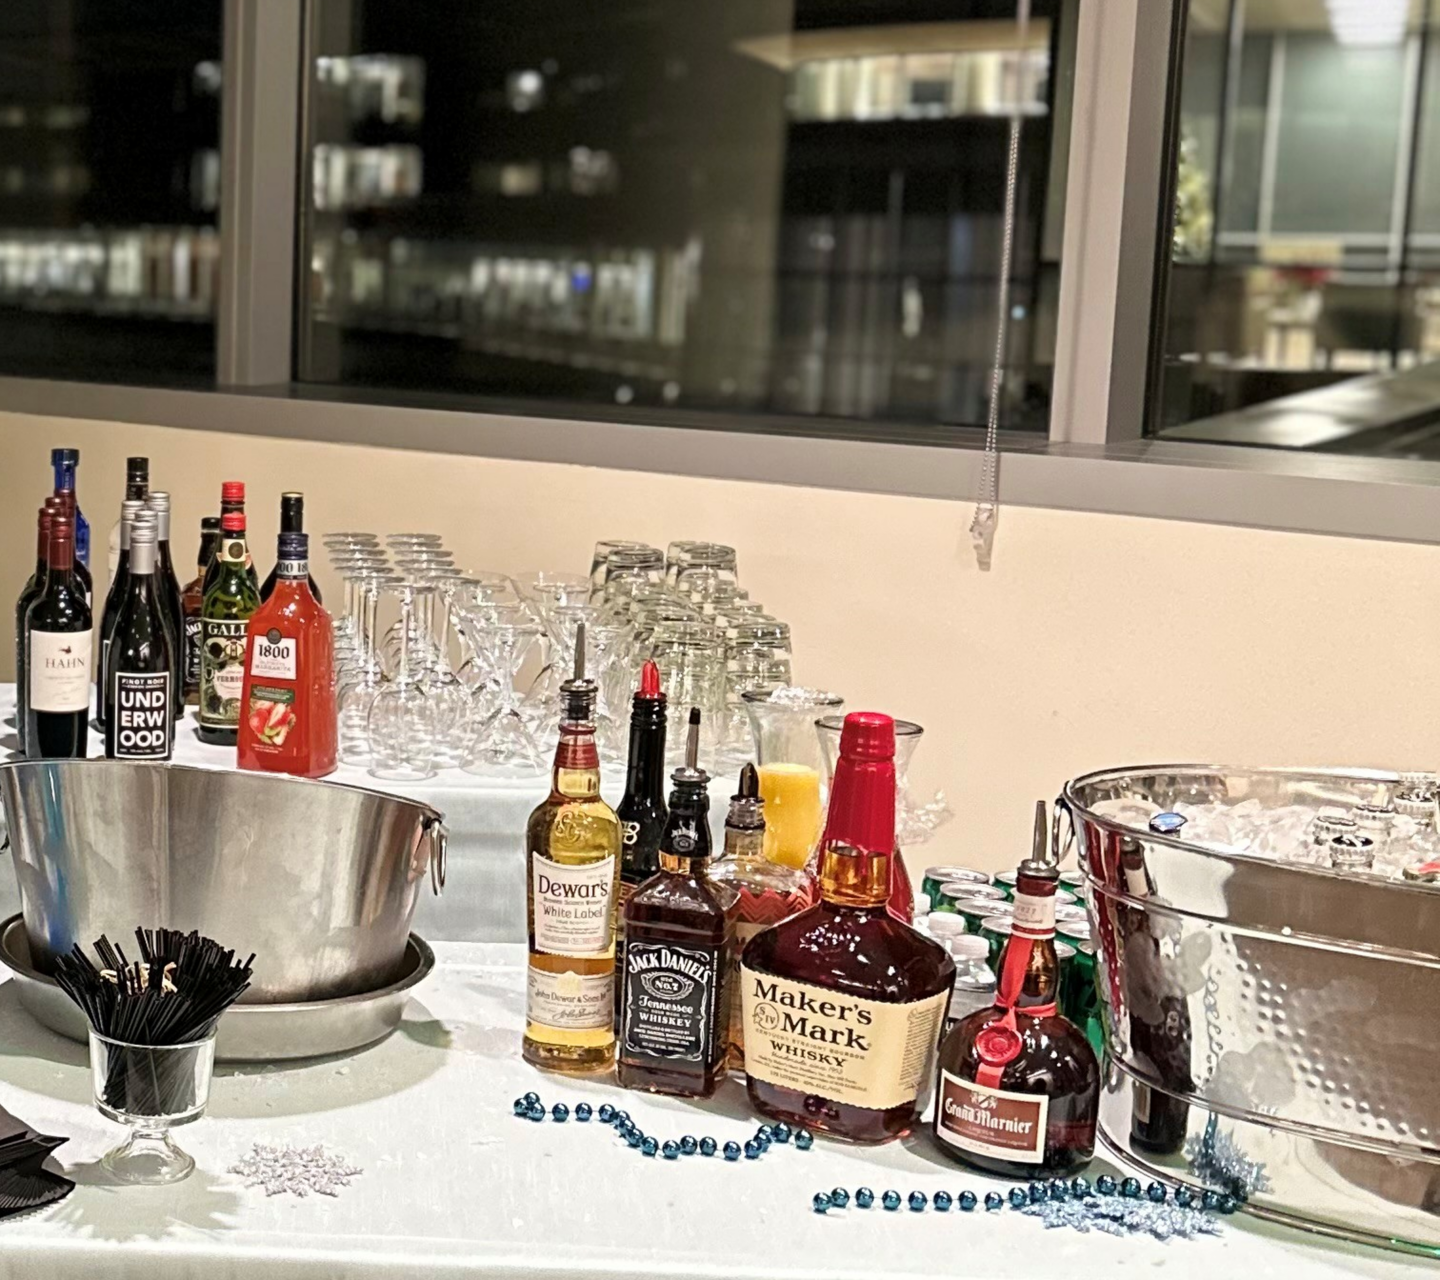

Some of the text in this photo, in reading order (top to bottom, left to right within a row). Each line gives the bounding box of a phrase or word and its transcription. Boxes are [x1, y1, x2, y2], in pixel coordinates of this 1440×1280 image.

[259, 644, 290, 659] 1800
[45, 657, 85, 669] HAHN
[121, 677, 165, 685] PINOT NOIR
[121, 691, 165, 708] UND
[121, 710, 165, 727] ERW
[120, 730, 165, 747] OOD
[538, 874, 608, 898] Dewar's
[629, 948, 712, 983] JACK DANIEL'S
[638, 994, 693, 1014] Tennessee
[753, 978, 873, 1026] Maker's
[639, 1012, 692, 1028] WHISKEY
[780, 1011, 870, 1052] Mark
[769, 1040, 848, 1068] WHISKY
[945, 1097, 975, 1123] Grand
[974, 1108, 1033, 1134] Marnier
